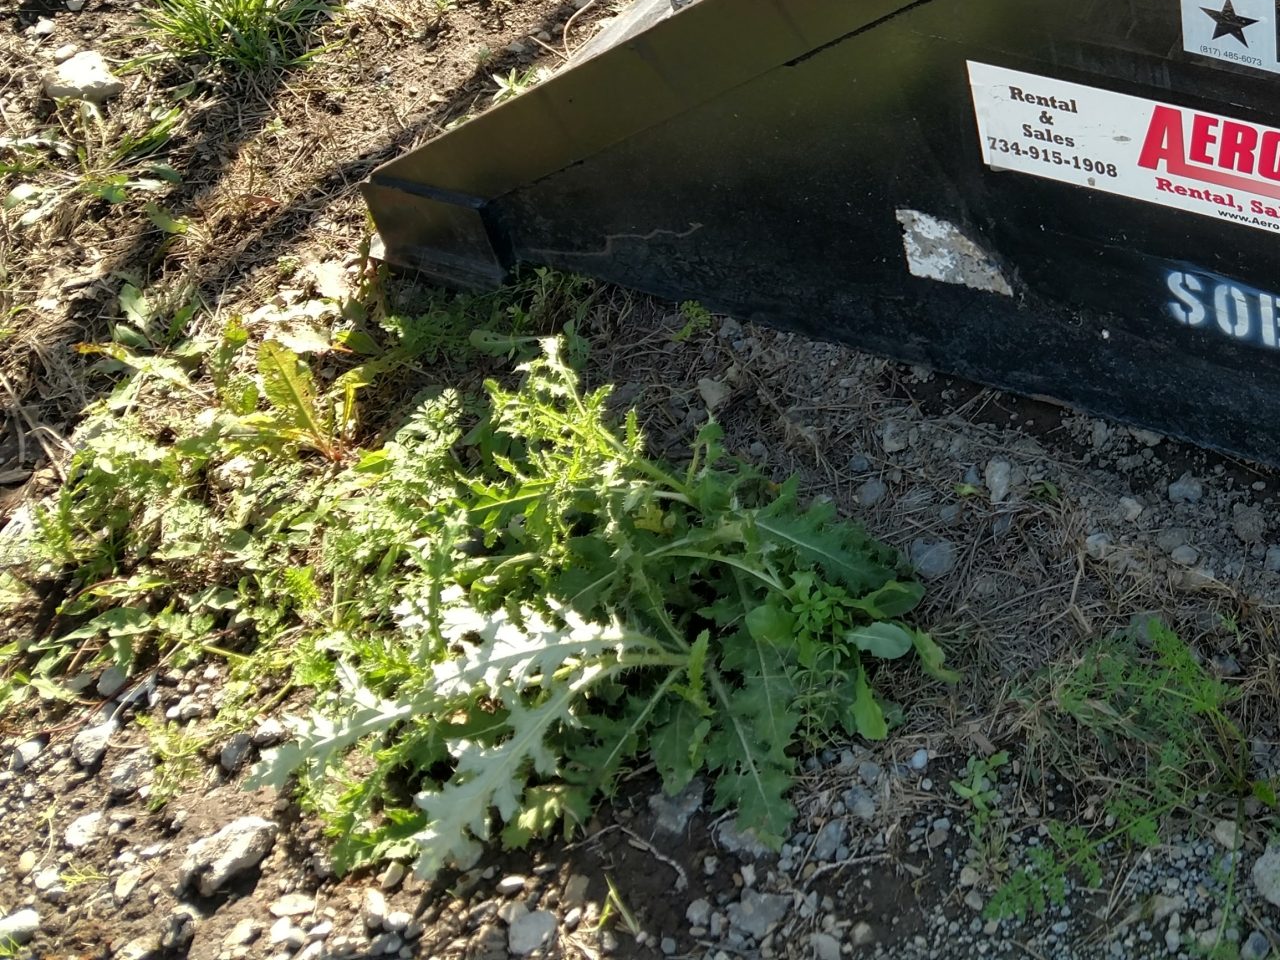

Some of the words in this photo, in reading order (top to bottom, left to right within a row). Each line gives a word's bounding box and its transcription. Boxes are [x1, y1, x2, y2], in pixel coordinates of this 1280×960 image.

[1200, 44, 1221, 58] (817)
[1223, 50, 1262, 67] 485-6073
[1008, 86, 1078, 113] Rental
[1039, 110, 1054, 125] &
[1022, 124, 1075, 147] Sales
[987, 136, 1118, 178] 734-915-1908
[1155, 177, 1243, 212] Rental,
